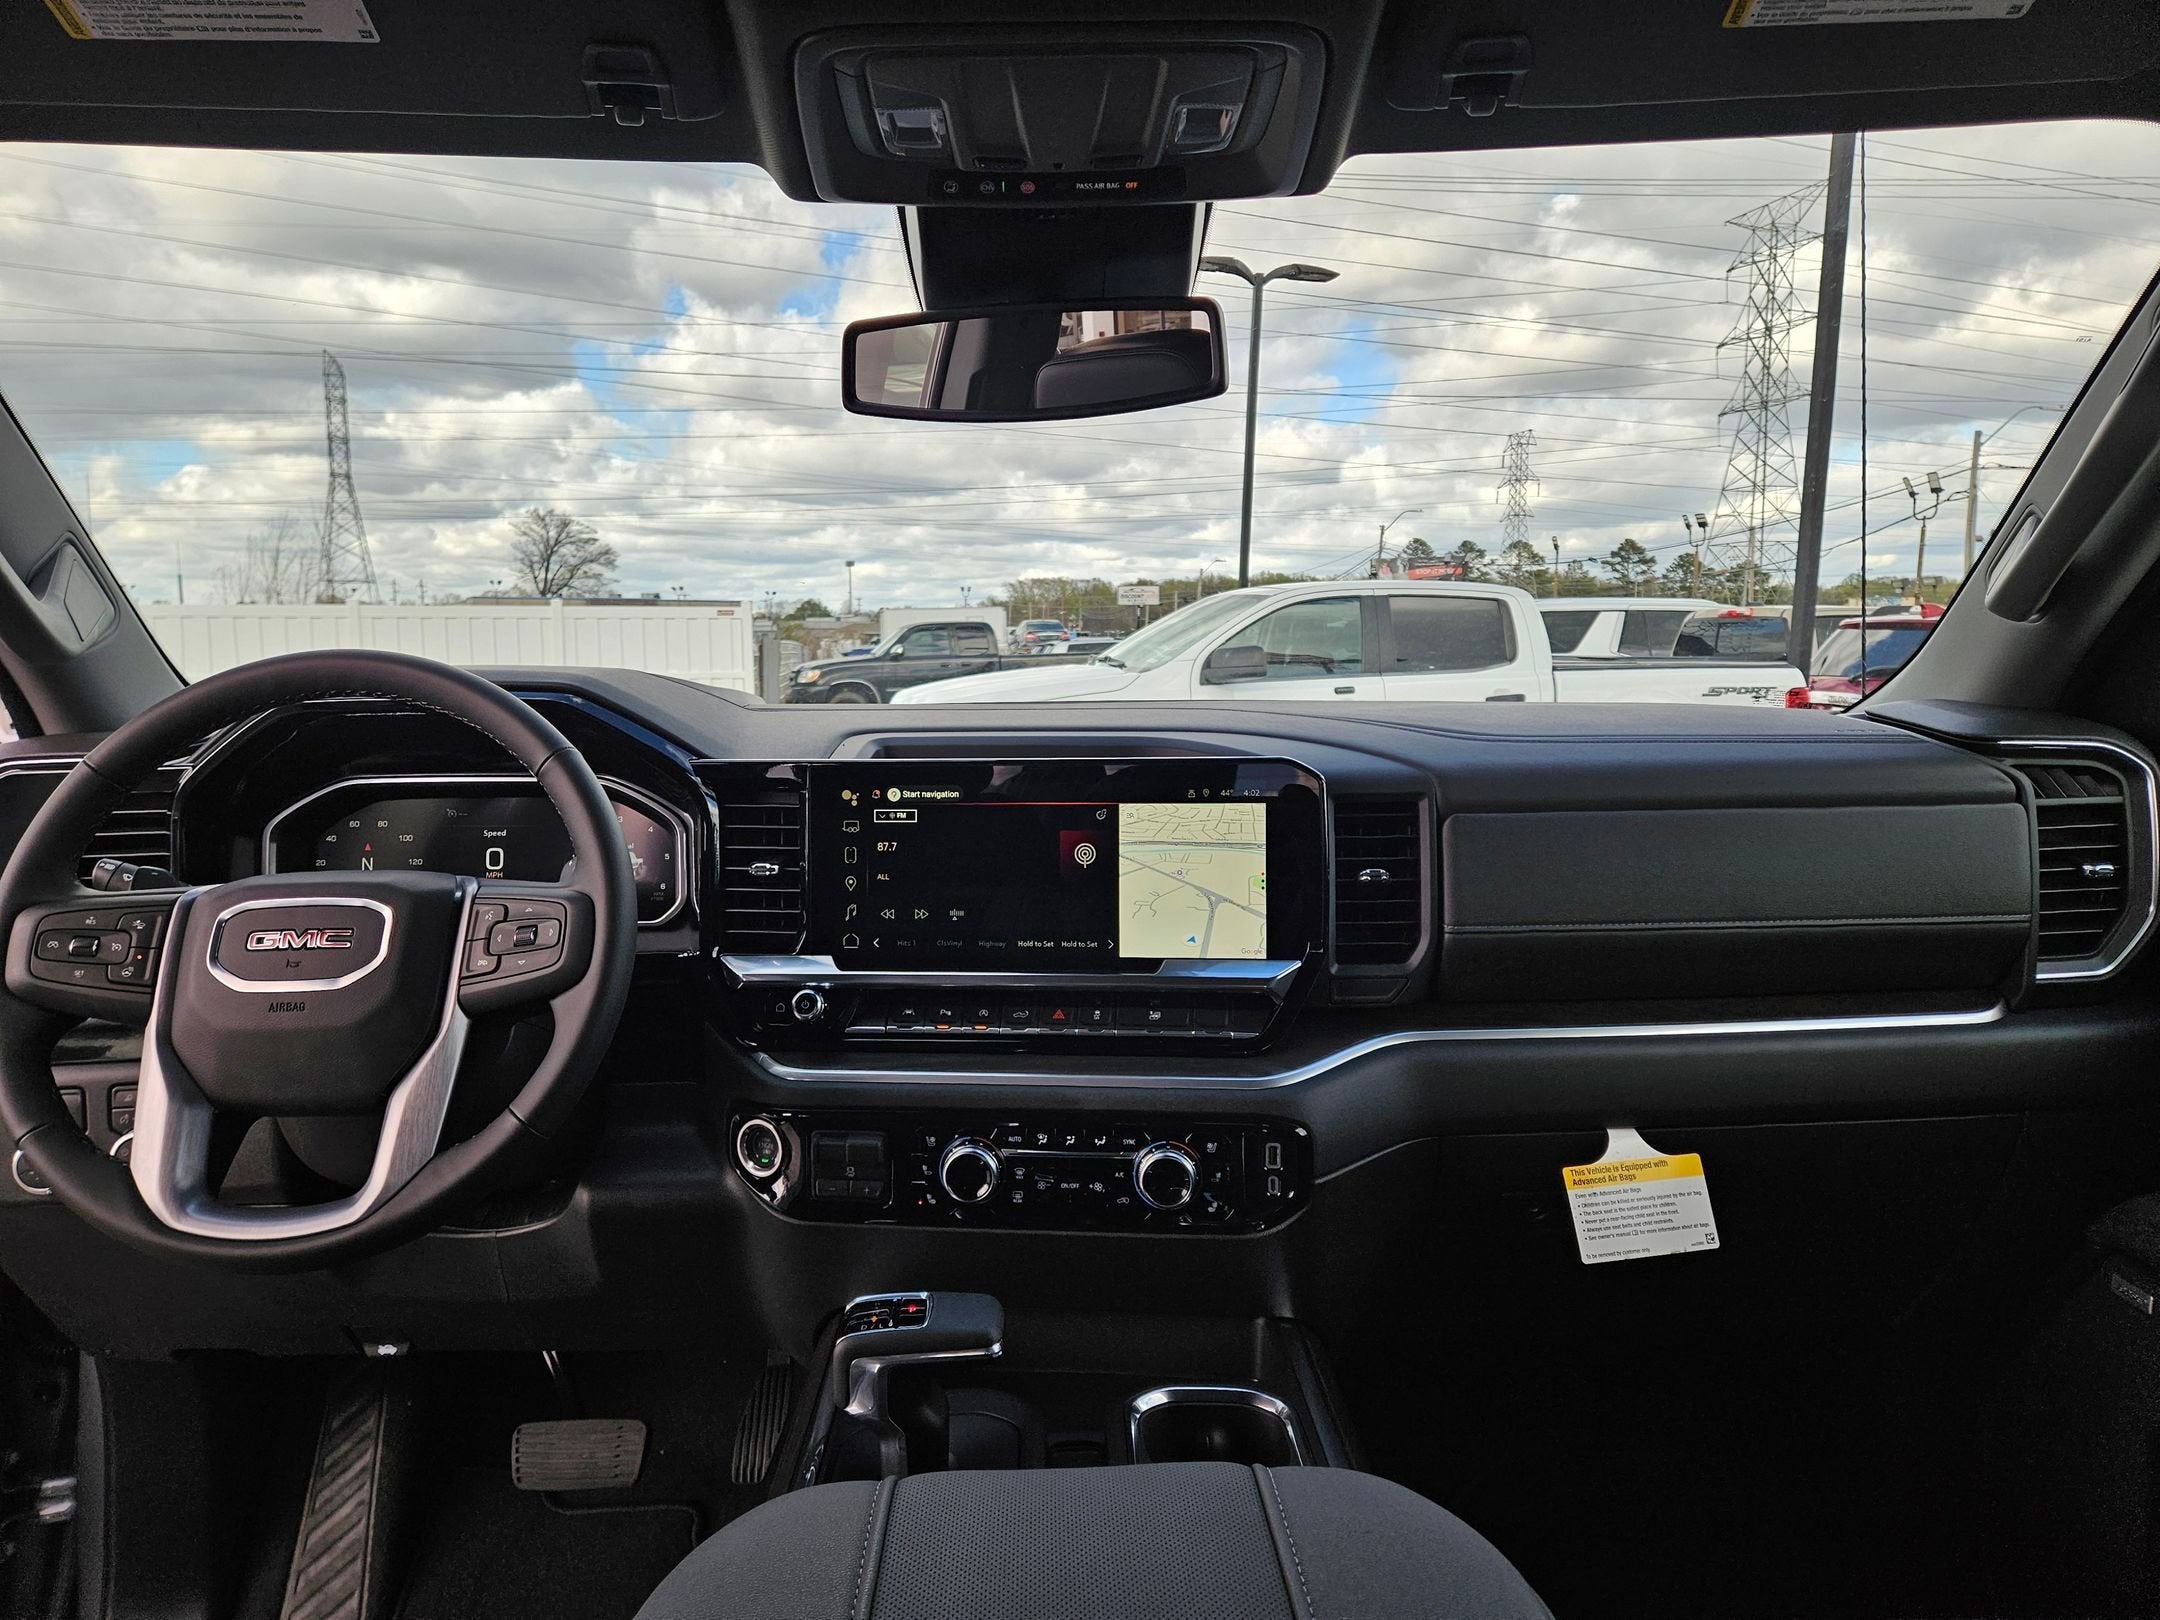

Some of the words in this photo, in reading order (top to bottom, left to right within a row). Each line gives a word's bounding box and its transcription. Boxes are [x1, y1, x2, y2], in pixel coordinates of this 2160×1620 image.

[1076, 182, 1093, 190] PASS
[1094, 182, 1105, 190] AIR
[1106, 182, 1120, 190] BAG
[1125, 181, 1138, 190] OFF
[1702, 686, 1777, 697] SPORT
[922, 790, 960, 800] navigation
[1243, 789, 1260, 797] 4:02
[349, 820, 360, 828] 60
[377, 820, 388, 828] 80
[483, 829, 507, 838] Speed
[326, 834, 337, 842] 40
[398, 834, 414, 842] 100
[877, 842, 898, 852] 87.7
[315, 859, 326, 867] 20
[408, 858, 423, 866] 120
[485, 847, 505, 871] 0
[361, 856, 374, 871] N
[246, 928, 353, 951] GMC
[1018, 940, 1034, 948] Hold
[1034, 940, 1042, 948] to
[1042, 940, 1054, 948] Set
[1061, 940, 1077, 948] Hold
[1078, 940, 1085, 948] to
[1086, 940, 1098, 948] Set
[1240, 947, 1264, 956] Google
[268, 1002, 306, 1013] AIRBAG
[1122, 1138, 1136, 1146] SYNC
[1570, 1169, 1586, 1177] This
[1586, 1165, 1612, 1176] Vehicle
[1613, 1164, 1620, 1172] is
[1620, 1160, 1652, 1172] Equipped
[1653, 1160, 1669, 1168] with
[1572, 1176, 1606, 1186] Advanced
[1608, 1174, 1618, 1182] Air
[1619, 1172, 1637, 1182] Bags
[1060, 1182, 1080, 1190] ON/OFF
[1575, 1192, 1588, 1200] Even
